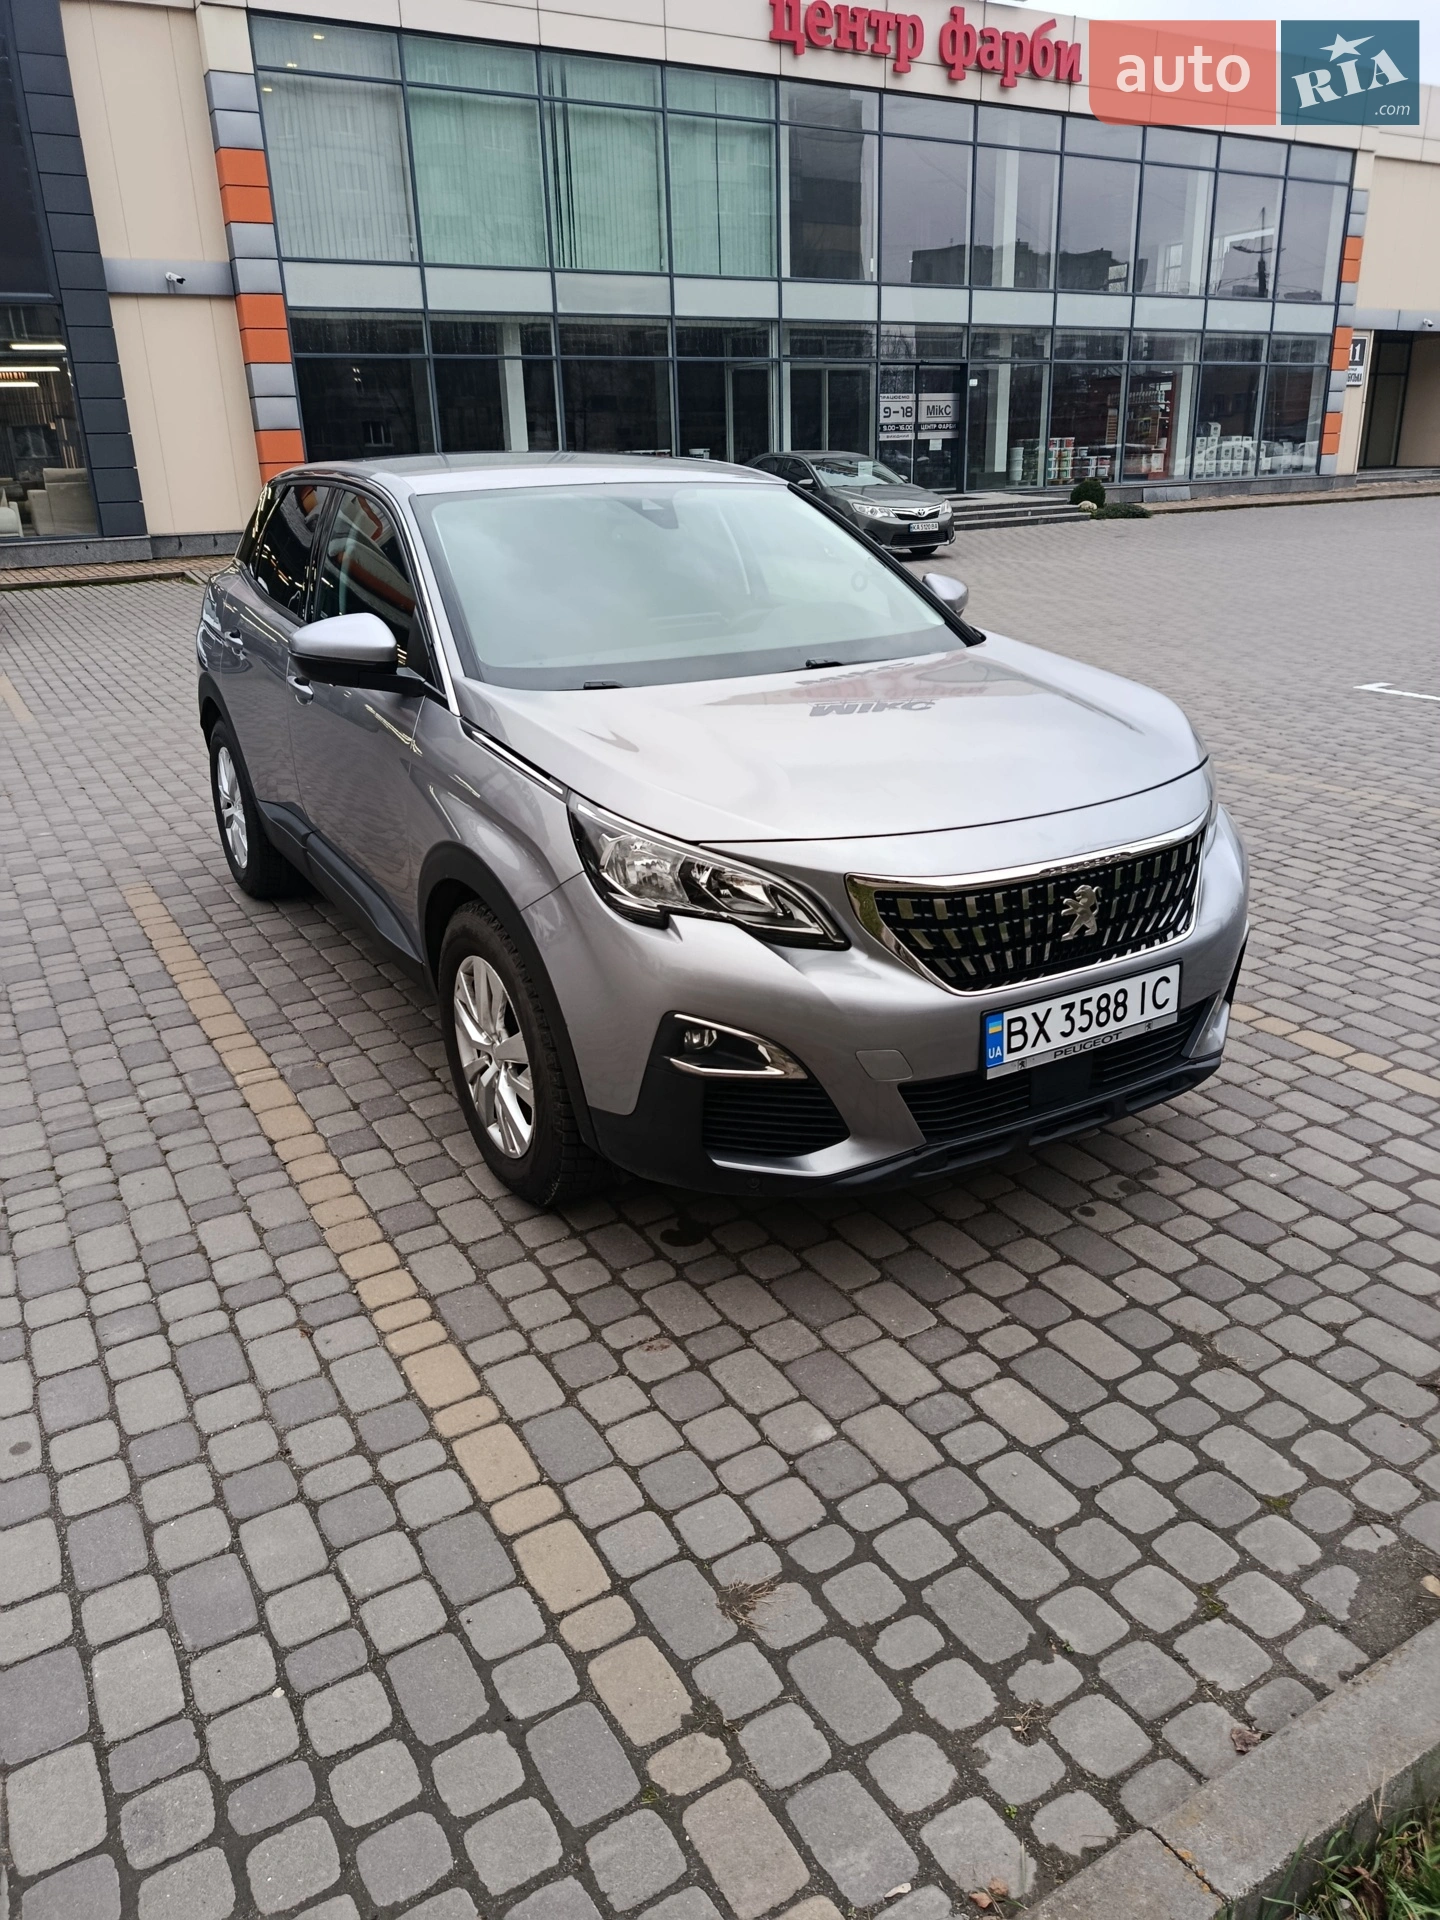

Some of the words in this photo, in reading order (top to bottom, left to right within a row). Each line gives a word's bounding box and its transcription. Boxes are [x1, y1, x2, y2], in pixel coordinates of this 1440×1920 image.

[939, 6, 1082, 87] фарби
[1349, 343, 1361, 361] 11
[927, 405, 951, 416] MikC
[1006, 1007, 1053, 1055] BX
[1059, 987, 1129, 1039] 3588
[1140, 975, 1172, 1016] IC
[988, 1046, 1003, 1059] UA
[1053, 1031, 1123, 1059] PEUGEOT
